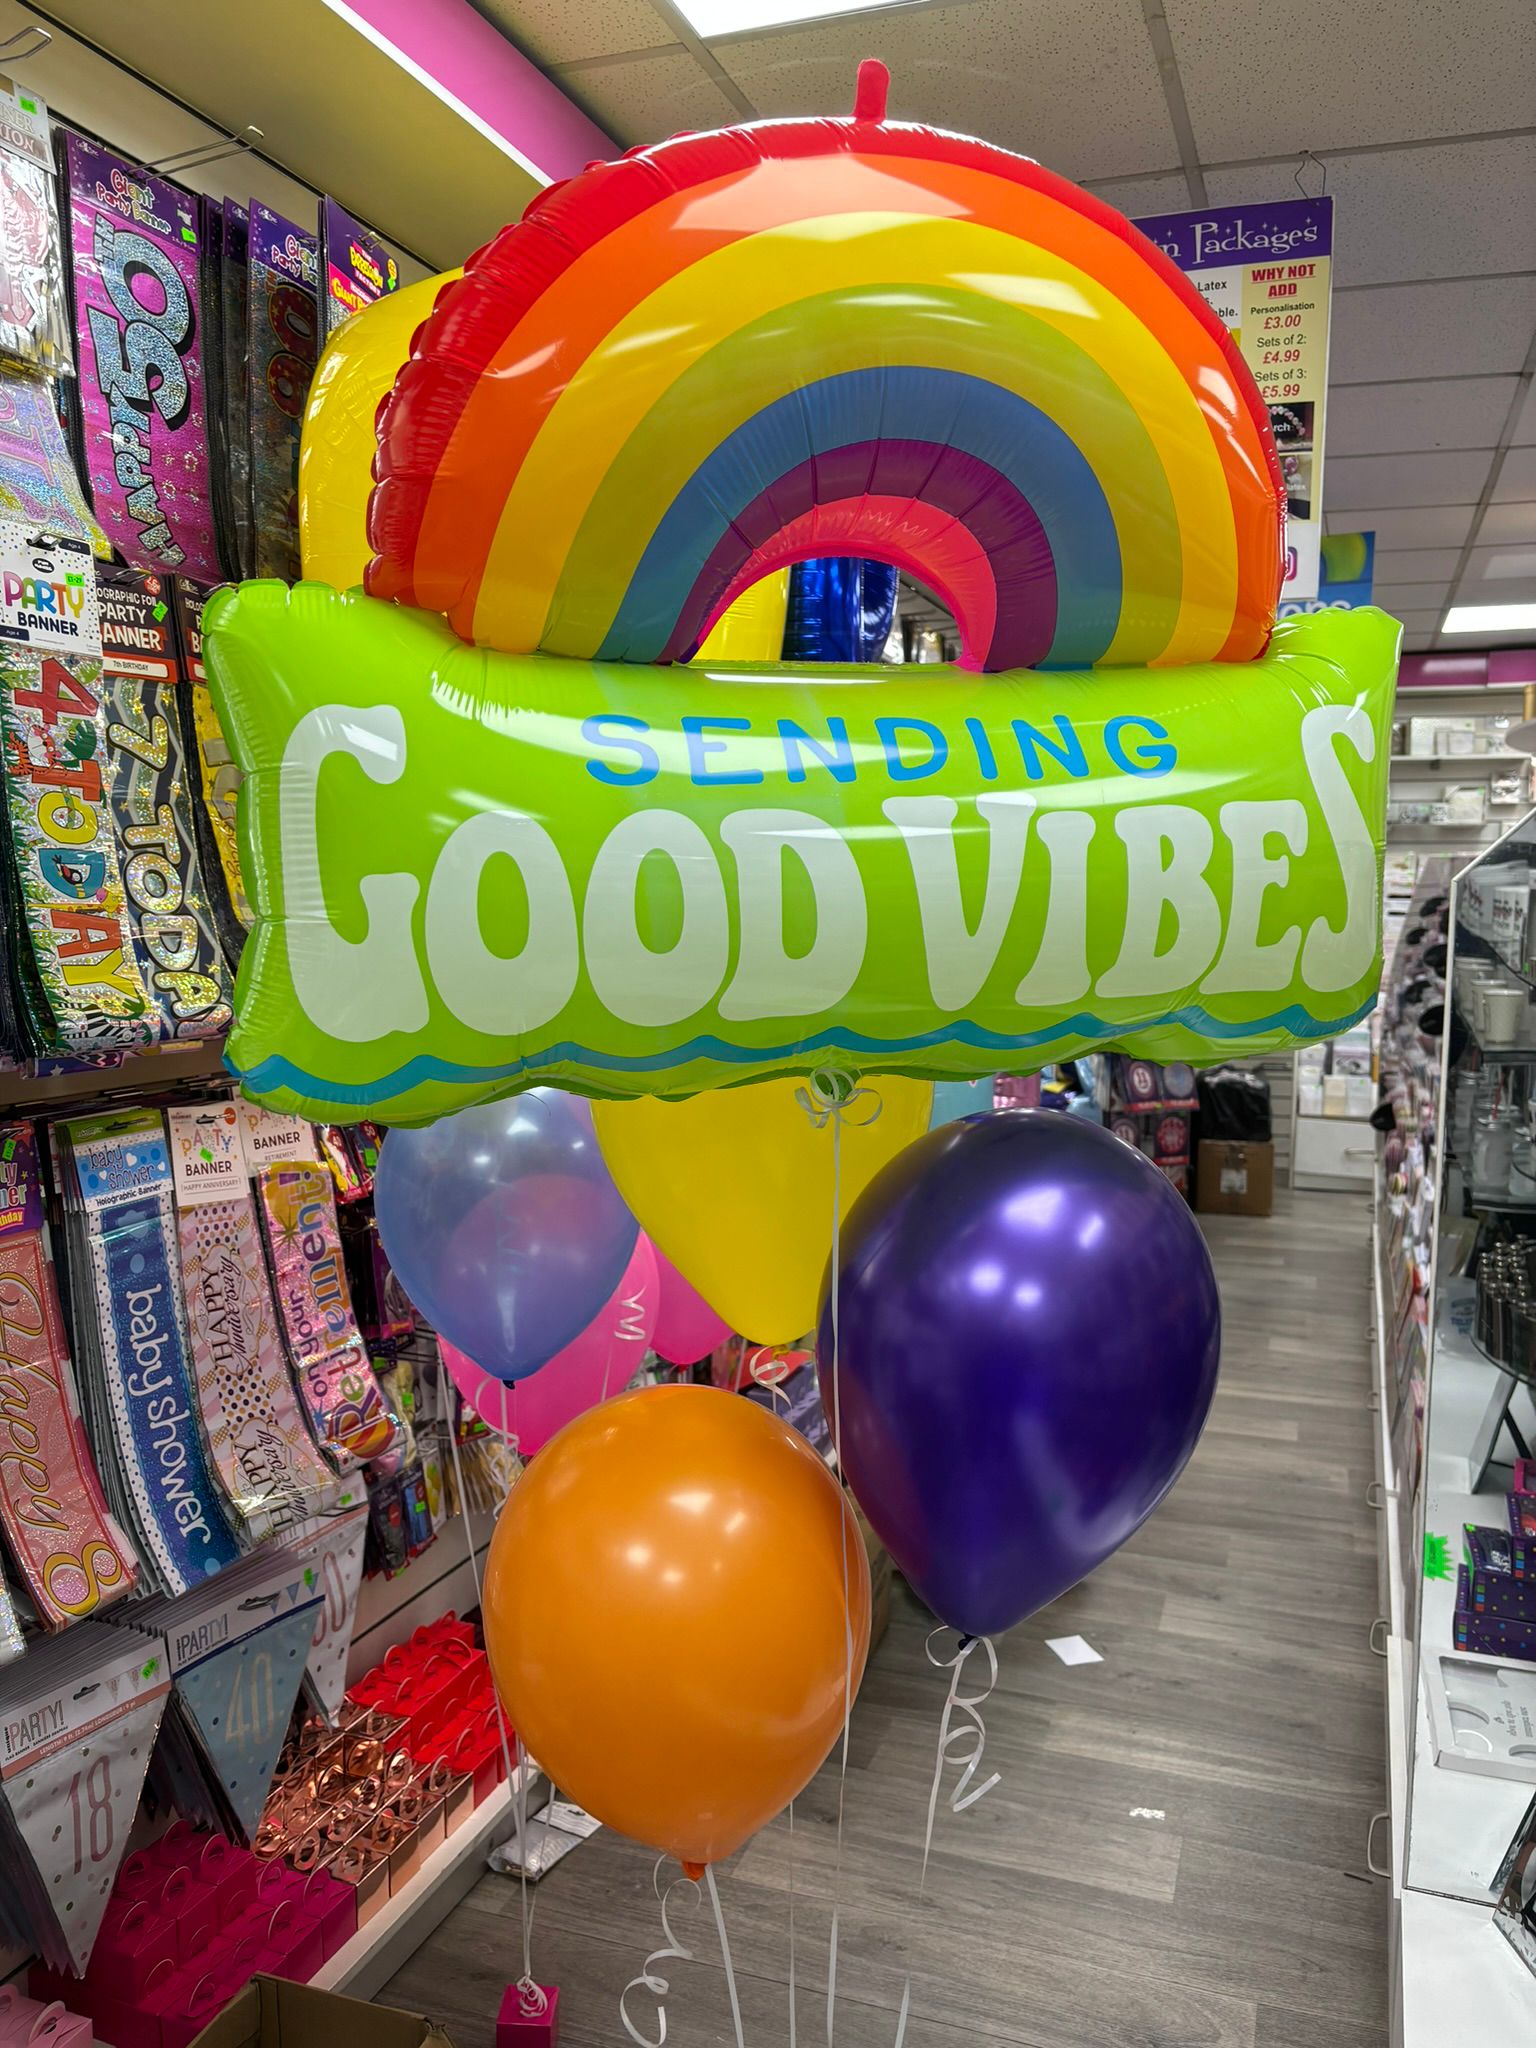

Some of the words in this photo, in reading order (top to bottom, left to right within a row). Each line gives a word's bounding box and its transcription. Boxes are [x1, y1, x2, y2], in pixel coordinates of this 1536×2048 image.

[95, 181, 131, 216] Party
[131, 200, 172, 234] Banner
[285, 234, 318, 266] Gian
[1189, 219, 1319, 265] Packages
[271, 245, 301, 277] Party
[1251, 267, 1284, 281] WHY
[1288, 264, 1316, 279] NOT
[1197, 280, 1228, 292] Latex
[1268, 283, 1298, 297] ADD
[1250, 302, 1315, 315] Personalisation
[1264, 314, 1302, 330] £3.00
[1257, 337, 1280, 348] Sets
[1283, 334, 1295, 346] of
[1297, 333, 1307, 345] 2:
[1263, 349, 1301, 364] £4.99
[1255, 372, 1279, 382] Sets
[1283, 369, 1294, 380] of
[1297, 368, 1307, 379] 3:
[1262, 384, 1301, 398] £5.99
[1273, 422, 1291, 432] rch
[109, 380, 187, 567] HAPPY
[3, 570, 86, 619] PARTY
[96, 587, 140, 604] OGRAPHIC
[17, 611, 79, 637] BANNER
[97, 601, 147, 625] PARTY
[102, 621, 162, 651] ANNER
[122, 661, 149, 672] BIRTHDAY
[14, 657, 99, 725] 4
[106, 714, 169, 772] 7
[580, 713, 1178, 786] SENDING
[31, 758, 141, 1000] TODAY
[280, 703, 868, 1043] GOOD
[881, 703, 1376, 1013] VIBES
[253, 1131, 301, 1150] BANNER
[88, 1145, 124, 1169] baby
[185, 1160, 233, 1177] BANNER
[264, 1150, 298, 1162] RETIREMENT
[108, 1163, 155, 1190] shower
[0, 1181, 27, 1209] ner
[96, 1190, 137, 1207] Holographic
[137, 1183, 163, 1198] Banner
[201, 1267, 234, 1364] HAPPY
[289, 1287, 320, 1358] your
[126, 1283, 173, 1397] baby
[307, 1361, 329, 1399] on
[148, 1395, 212, 1545] shower
[180, 1613, 230, 1659] PARTY!
[225, 1652, 274, 1745] 40
[8, 1700, 65, 1752] PARTY!
[64, 1755, 114, 1876] 18
